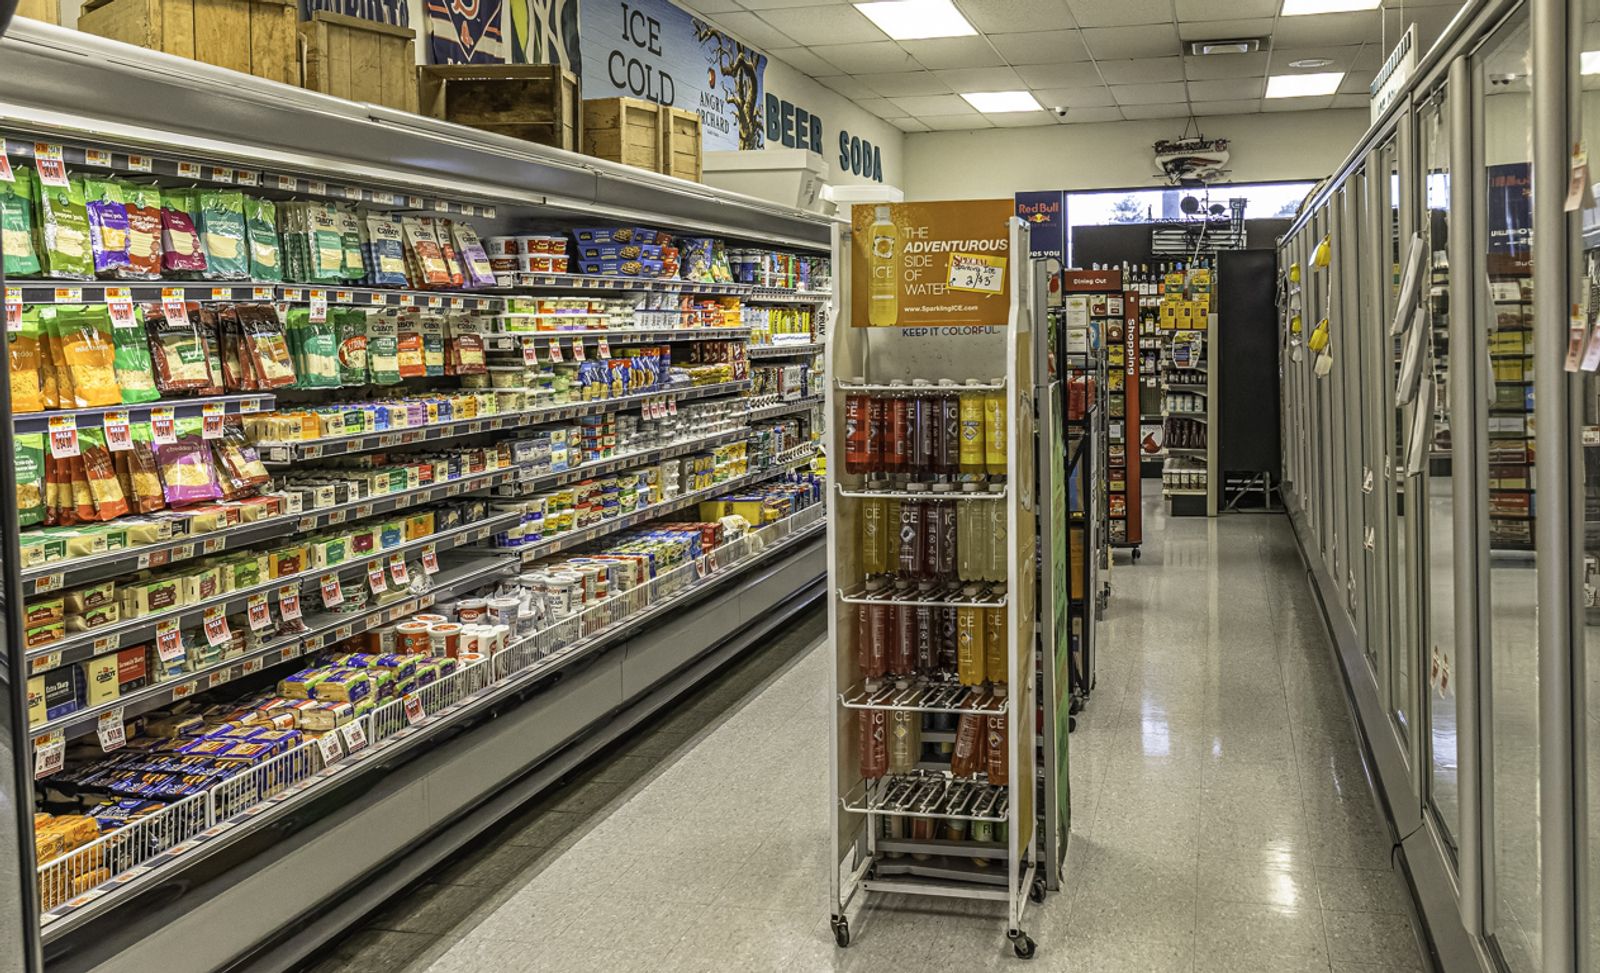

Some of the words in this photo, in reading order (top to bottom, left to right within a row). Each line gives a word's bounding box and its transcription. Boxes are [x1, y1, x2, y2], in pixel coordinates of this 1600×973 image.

[621, 2, 662, 57] ICE
[608, 50, 675, 107] COLD
[699, 91, 725, 114] ANGRY
[696, 107, 730, 135] RCHARD
[765, 92, 824, 156] BEER
[839, 130, 883, 183] SODA
[1018, 203, 1038, 214] Red
[1039, 202, 1059, 213] Bull
[904, 227, 928, 240] THE
[904, 239, 1008, 254] ADVENTUROUS
[904, 255, 934, 267] SIDE
[873, 266, 893, 278] ICE
[904, 269, 922, 281] OF
[818, 310, 826, 336] TRULY
[902, 327, 928, 337] KEEP
[929, 327, 940, 336] IT
[1127, 319, 1138, 375] Shopping
[864, 508, 881, 519] CE
[901, 512, 919, 524] CE
[959, 615, 975, 628] CE
[988, 614, 1002, 626] CE
[96, 670, 117, 682] CABOT
[894, 711, 911, 722] CE
[989, 717, 1005, 729] CE
